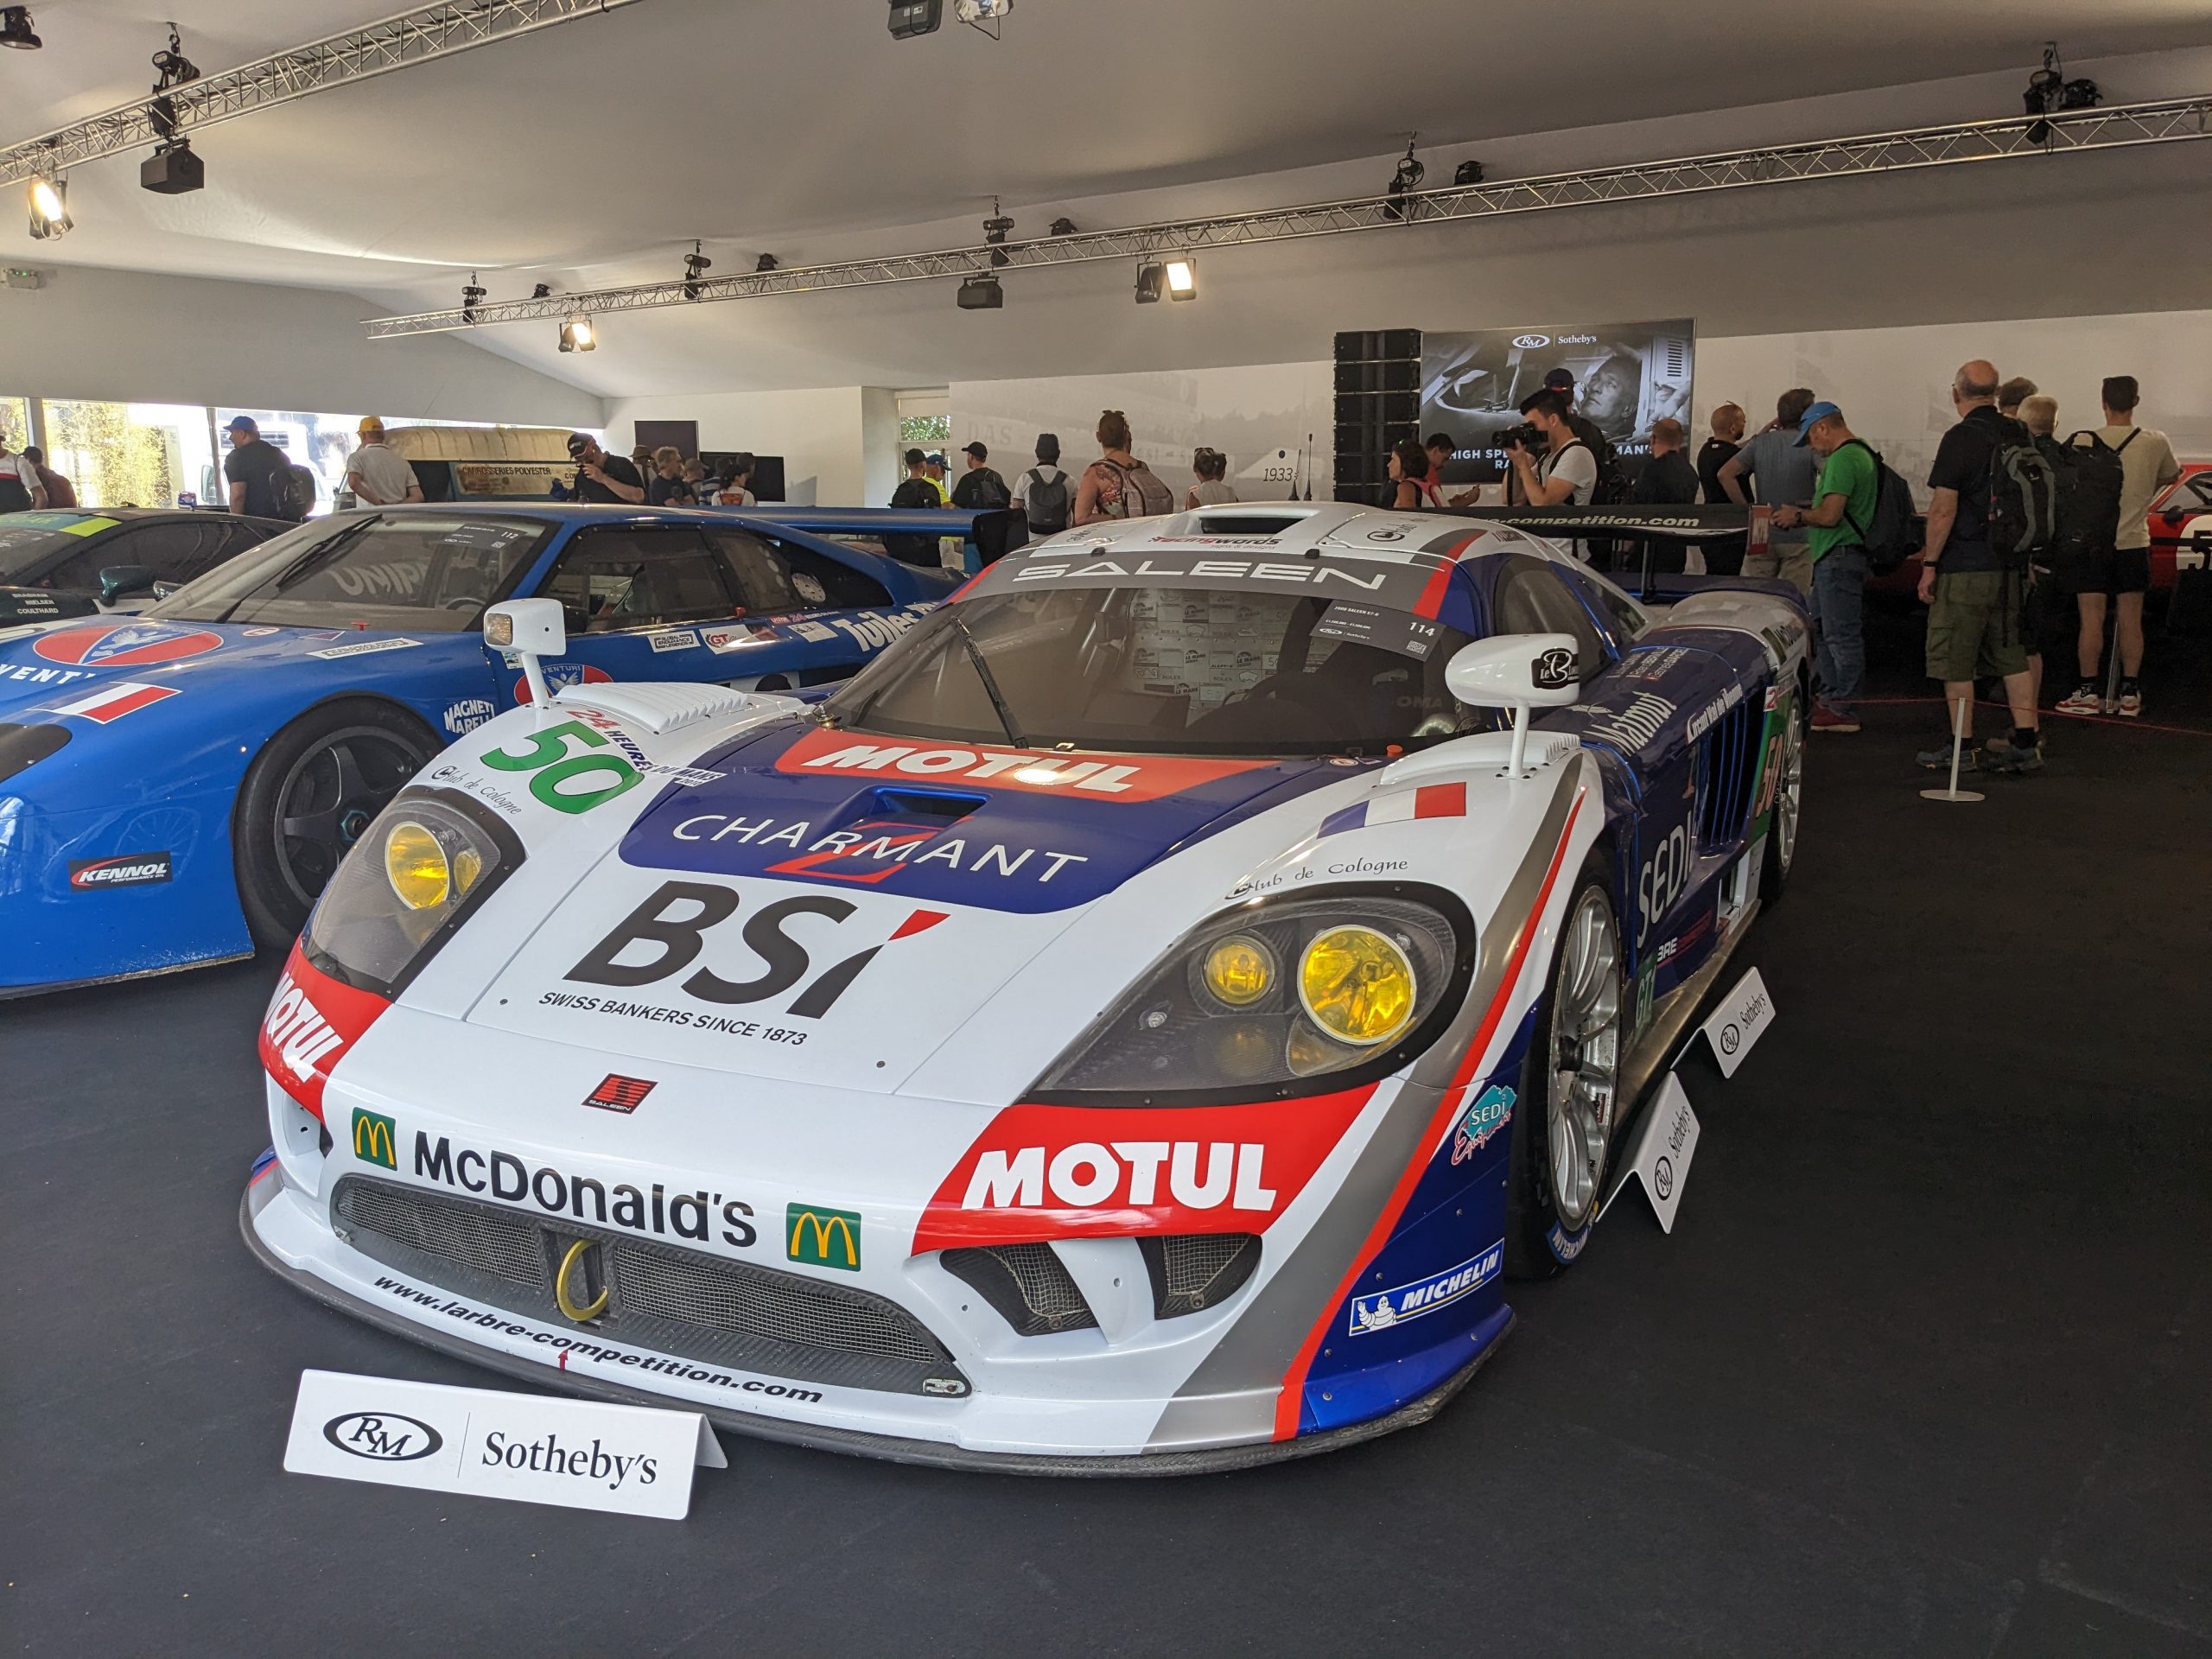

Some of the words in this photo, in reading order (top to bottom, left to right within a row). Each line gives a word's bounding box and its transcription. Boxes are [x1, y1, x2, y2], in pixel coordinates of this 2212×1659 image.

[1558, 334, 1597, 345] Sotheby's
[514, 467, 551, 475] POLYESTER
[1450, 449, 1481, 460] HIGH
[501, 531, 518, 540] 112
[1013, 560, 1386, 590] SALEEN
[710, 633, 728, 645] GT
[1409, 621, 1436, 637] 114
[0, 664, 96, 684] VENT
[541, 664, 582, 674] VENTURI
[567, 709, 621, 729] 24
[1583, 690, 1678, 758] Matmut
[480, 720, 645, 815] 50
[801, 745, 1144, 793] MOTUL
[464, 778, 480, 791] de
[480, 785, 522, 815] Cologne
[671, 814, 1089, 883] CHARMANT
[78, 862, 168, 883] KENNOL
[111, 874, 154, 883] PERFORMANCE
[1294, 866, 1314, 880] de
[1328, 856, 1409, 875] Cologne
[1637, 810, 1692, 949] SEDI
[264, 971, 345, 1084] MOTUL
[539, 992, 601, 1011] SWISS
[599, 1000, 694, 1027] BANKERS
[692, 1014, 760, 1038] SINCE
[763, 1026, 809, 1046] 1873
[1739, 993, 1767, 1030] Sotheby's
[588, 1099, 632, 1112] SALEEN
[1471, 1094, 1506, 1126] SEDI
[1668, 1105, 1691, 1160] Sotheby's
[415, 1129, 758, 1248] McDonald's
[961, 1141, 1278, 1211] MOTUL
[1401, 1249, 1500, 1312] MICHELIN
[373, 1274, 823, 1404] www.larbre-competition.com
[348, 1417, 412, 1457] RM
[481, 1431, 658, 1491] Sotheby's
